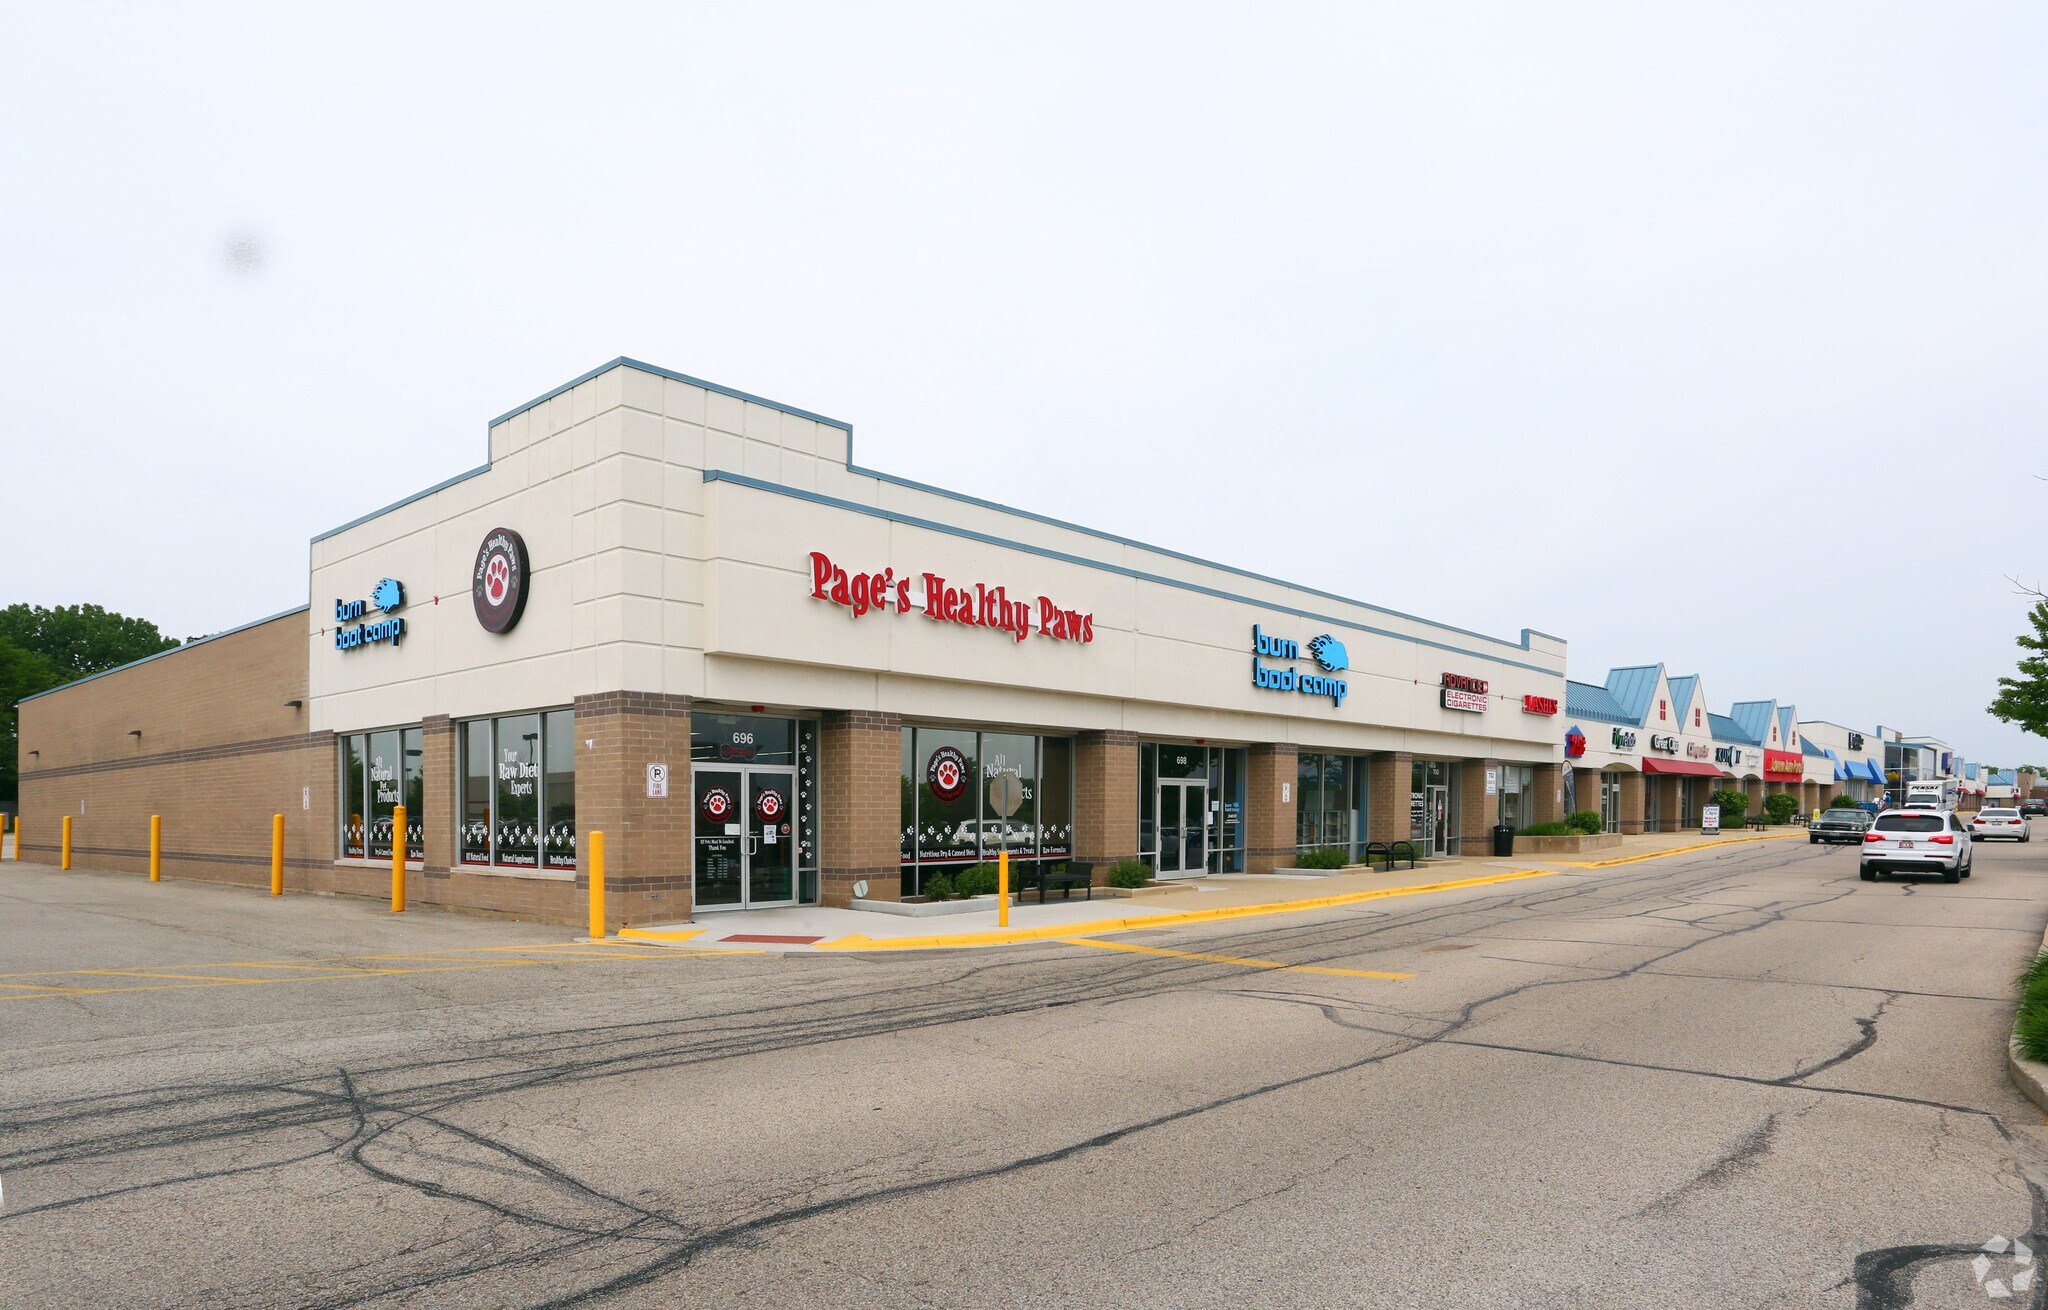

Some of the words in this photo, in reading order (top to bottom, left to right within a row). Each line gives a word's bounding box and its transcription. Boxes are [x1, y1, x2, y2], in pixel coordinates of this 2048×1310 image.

[477, 548, 490, 580] Page's
[488, 534, 510, 552] Healthy
[507, 543, 518, 571] Paws
[809, 551, 910, 618] Page's
[921, 573, 1031, 642] Healthy
[1036, 596, 1094, 643] Paws
[335, 598, 366, 622] burn
[335, 623, 364, 650] boot
[364, 617, 404, 646] camp
[1253, 624, 1299, 659] burn
[1253, 657, 1299, 691] boot
[1300, 675, 1347, 707] camp
[1443, 672, 1483, 693] ADVANCE
[1446, 690, 1488, 703] ELECTRONIC
[1524, 695, 1558, 714] LASHES
[1446, 699, 1488, 711] CIGARETTES
[732, 732, 754, 744] 696
[1652, 735, 1668, 750] Great
[504, 749, 517, 762] Your
[930, 755, 941, 771] Page's
[940, 750, 959, 761] Healthy
[994, 754, 1005, 766] All
[1176, 756, 1187, 765] 698
[371, 766, 392, 781] Natural
[499, 763, 517, 780] Raw
[519, 763, 538, 778] Diet
[377, 787, 399, 803] Products
[511, 780, 532, 796] Experts
[502, 853, 514, 863] Natural
[514, 854, 535, 864] Supplements
[920, 850, 940, 858] Nutritious
[951, 849, 966, 857] Canned
